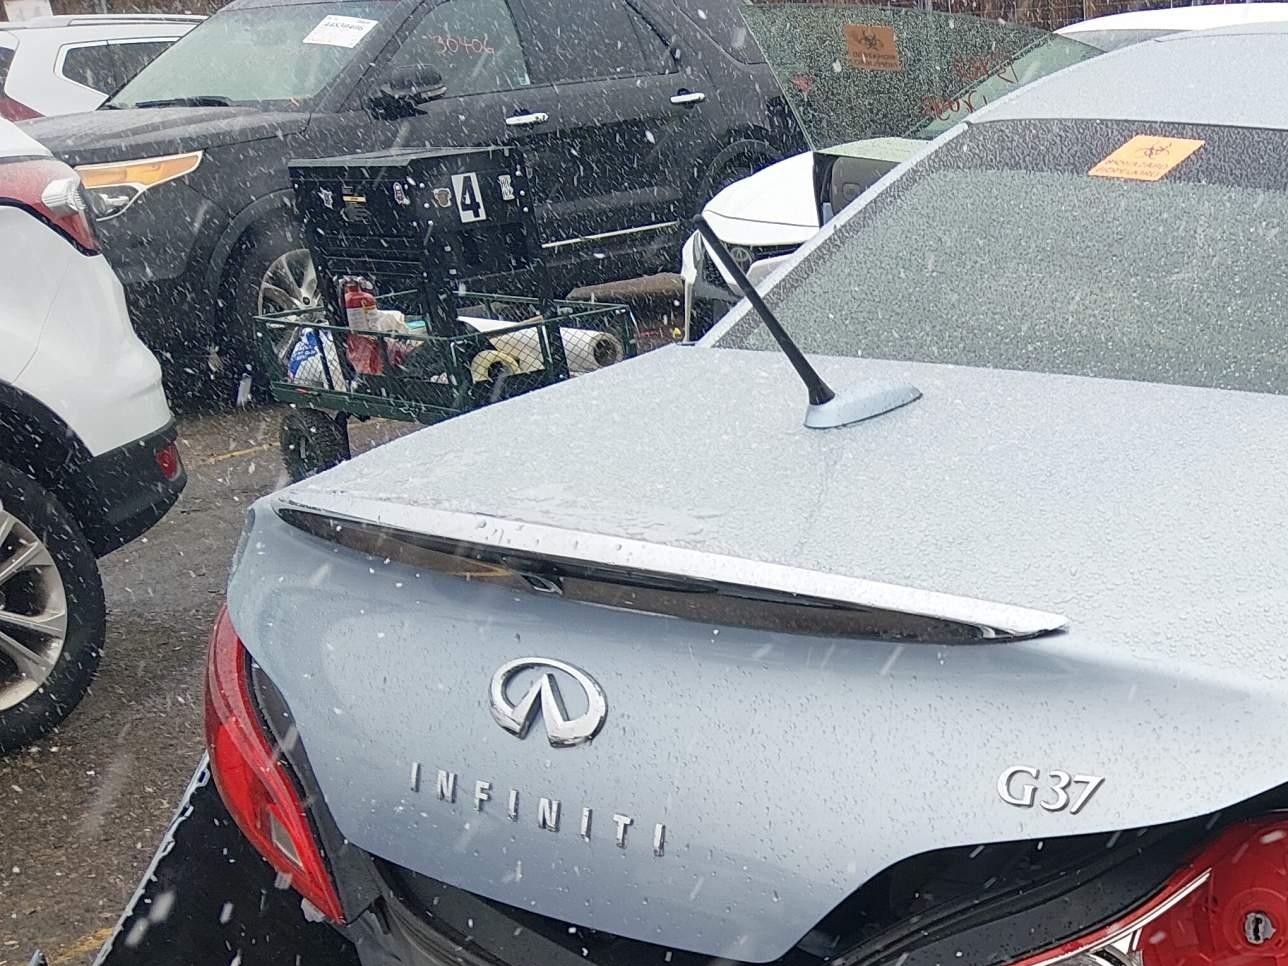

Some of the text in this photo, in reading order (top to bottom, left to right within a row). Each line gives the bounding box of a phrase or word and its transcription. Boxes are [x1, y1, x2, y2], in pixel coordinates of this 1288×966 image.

[460, 175, 481, 218] 4
[410, 761, 667, 857] INFINITI
[997, 765, 1106, 816] G37
